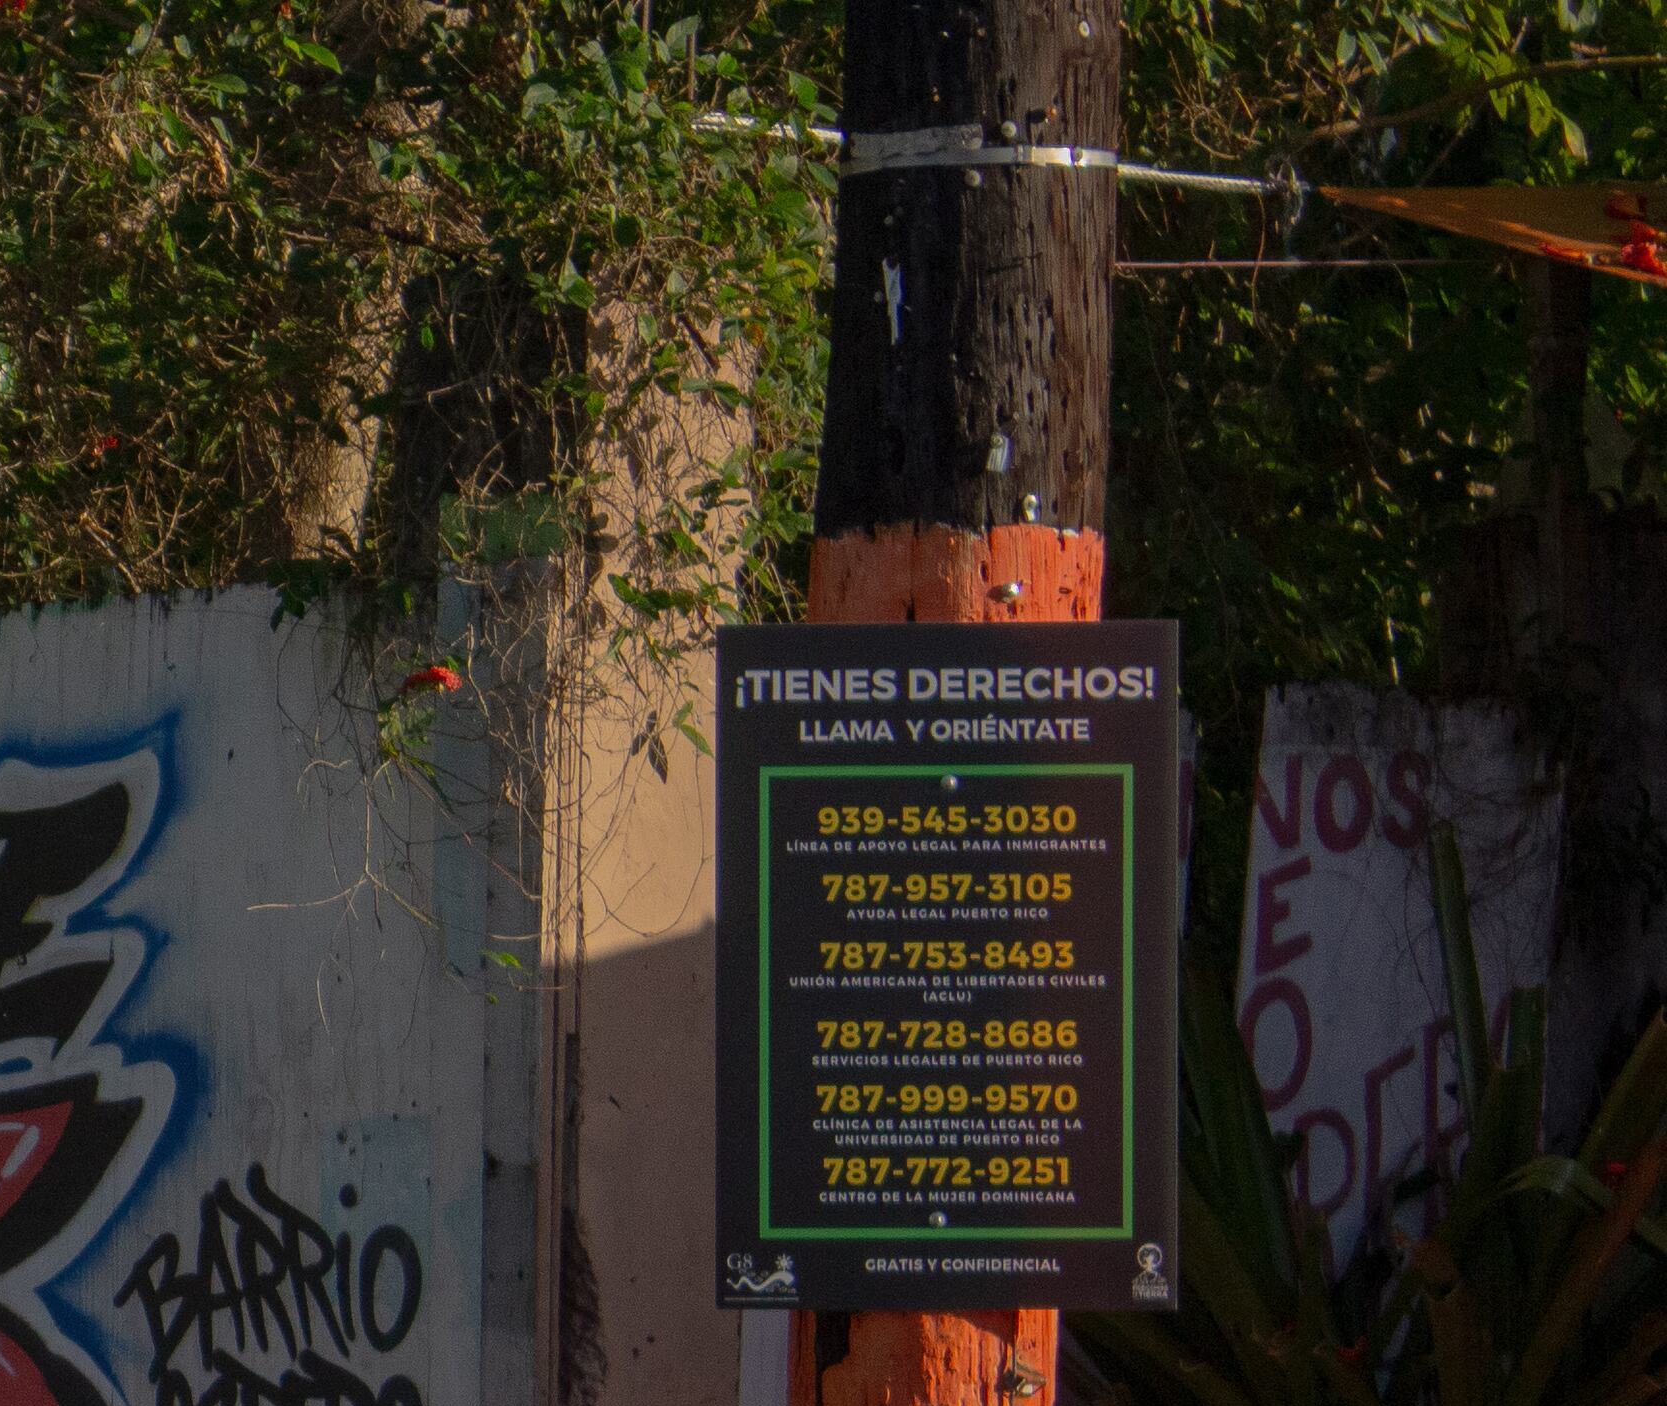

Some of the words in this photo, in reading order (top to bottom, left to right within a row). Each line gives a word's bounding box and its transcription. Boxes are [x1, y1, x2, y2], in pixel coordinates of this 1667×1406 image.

[735, 668, 899, 708] ¡TIENES
[908, 666, 1157, 702] DERECHOS!
[799, 718, 896, 744] LLAMA
[905, 718, 927, 743] Y
[929, 713, 1091, 743] ORIÉNTATE
[817, 804, 1078, 835] 939-545-3030
[786, 838, 829, 852] LÍNEA
[833, 840, 854, 852] DE
[857, 840, 908, 852] APOYO
[912, 840, 958, 852] LEGAL
[962, 839, 1002, 851] PARA
[1006, 838, 1107, 851] INMIGRANTES
[822, 872, 1073, 902] 787-957-3105
[846, 908, 897, 921] AYUDA
[901, 907, 947, 920] LEGAL
[951, 907, 1009, 920] PUERTO
[1013, 906, 1050, 919] RICO
[819, 940, 1076, 970] 787-753-8493
[789, 974, 837, 988] UNIÓN
[840, 975, 928, 988] AMERICANA
[931, 975, 952, 987] DE
[955, 974, 1046, 987] LIBERTADES
[1049, 974, 1106, 986] CIVILES
[922, 990, 973, 1003] (ACLU)
[816, 1019, 1079, 1050] 787-728-8686
[812, 1054, 890, 1067] SERVICIOS
[893, 1054, 957, 1066] LEGALES
[961, 1054, 982, 1066] DE
[985, 1054, 1045, 1066] PUERTO
[1048, 1053, 1084, 1066] RICO
[816, 1083, 1079, 1114] 787-999-9570
[812, 1117, 871, 1131] CLÍNICA
[875, 1118, 895, 1130] DE
[898, 1118, 986, 1131] ASISTENCIA
[990, 1118, 1037, 1130] LEGAL
[1040, 1118, 1061, 1130] DE
[1064, 1118, 1083, 1130] LA
[834, 1133, 935, 1146] UNIVERSIDAD
[938, 1133, 959, 1146] DE
[962, 1133, 1021, 1146] PUERTO
[1024, 1133, 1061, 1145] RICO
[823, 1157, 1070, 1186] 787-772-9251
[818, 1190, 877, 1203] CENTRO
[881, 1190, 902, 1202] DE
[905, 1190, 924, 1202] LA
[928, 1190, 977, 1202] MUJER
[981, 1190, 1077, 1203] DOMINICANA
[114, 1162, 422, 1384] BARRIO
[864, 1258, 924, 1272] GRATIS
[927, 1258, 938, 1272] Y
[941, 1257, 1061, 1272] CONFIDENCIAL
